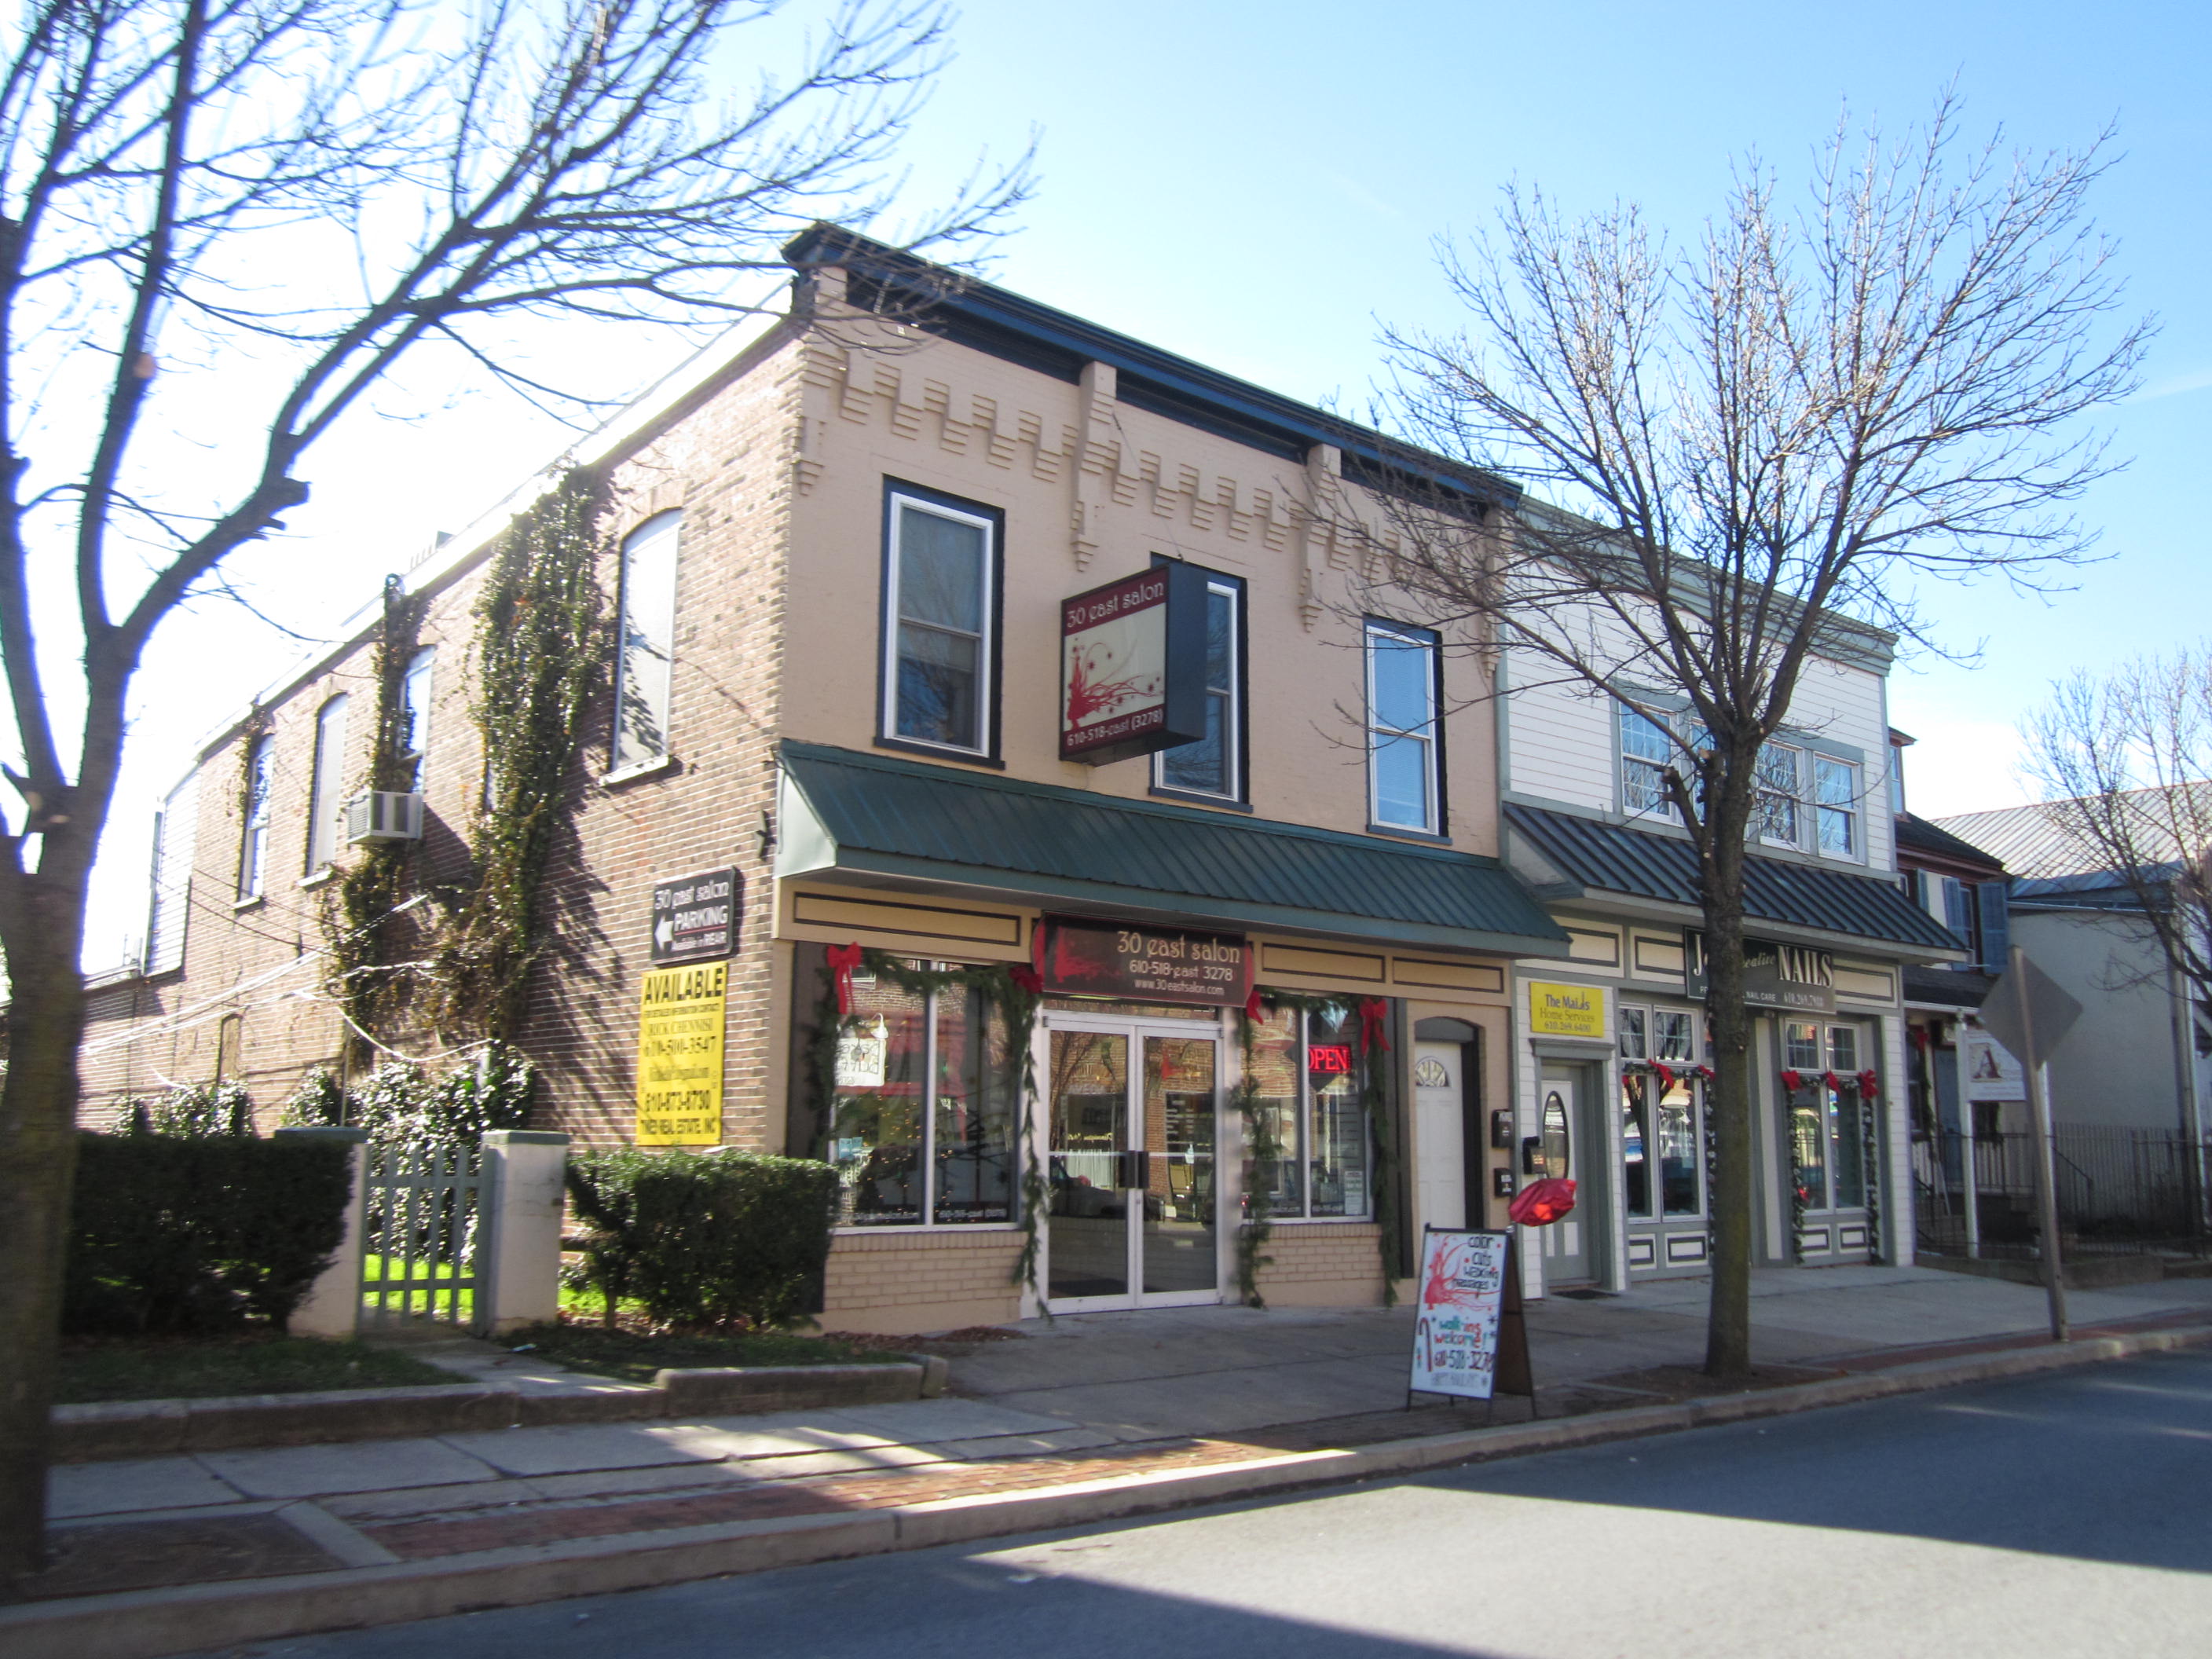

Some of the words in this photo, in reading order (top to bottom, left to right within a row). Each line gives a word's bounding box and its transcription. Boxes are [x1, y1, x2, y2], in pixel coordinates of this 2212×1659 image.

[1067, 607, 1086, 628] 30
[1089, 595, 1119, 622] east
[1122, 582, 1164, 609] salon
[1131, 708, 1164, 731] (3278)
[654, 888, 672, 910] 30
[696, 880, 729, 902] salon
[674, 904, 728, 932] PARKING
[1117, 930, 1141, 954] 30
[1147, 934, 1185, 958] east
[1191, 937, 1240, 964] salon
[1203, 965, 1233, 982] 3278
[1778, 945, 1833, 989] NAILS
[644, 968, 723, 1005] AVAILABLE
[1760, 992, 1777, 1002] CARE
[1540, 1007, 1563, 1020] Home
[1565, 1009, 1595, 1023] Services
[1545, 994, 1561, 1009] The
